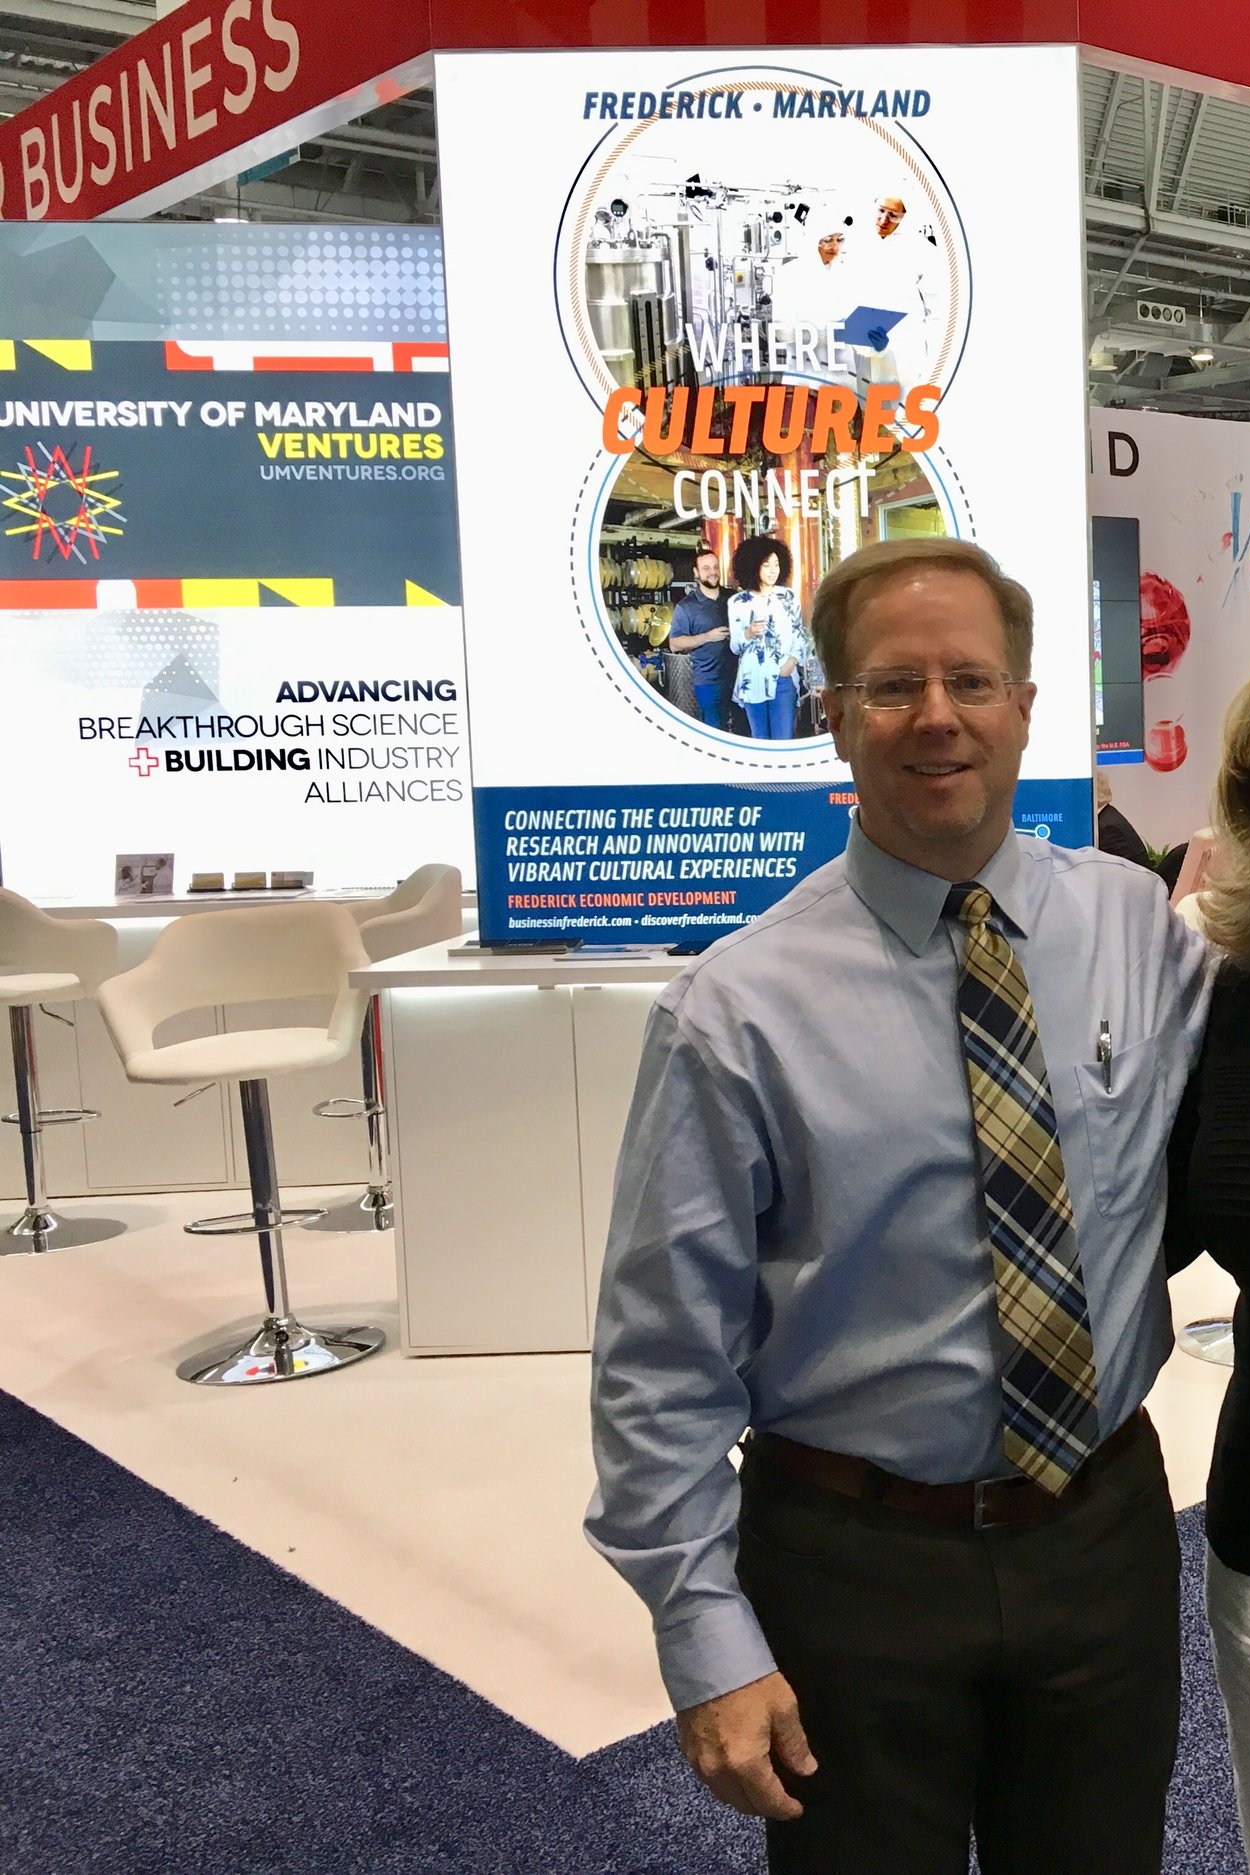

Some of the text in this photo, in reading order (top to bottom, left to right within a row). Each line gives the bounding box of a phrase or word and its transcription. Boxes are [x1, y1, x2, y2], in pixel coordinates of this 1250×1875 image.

[20, 0, 300, 220] BUSINESS
[583, 89, 931, 119] FREDERICK MARYLAND
[685, 322, 849, 373] WHERE
[0, 400, 442, 428] UNIVERSITY OF MARYLAND
[602, 385, 942, 456] CULTURES
[258, 432, 444, 459] VENTURES
[260, 464, 445, 481] UMVENTURES.ORG
[672, 467, 876, 519] CONNECT
[276, 680, 457, 702] ADVANCING
[79, 712, 458, 739] BREAKTHROUGH SCIENCE
[165, 746, 460, 772] BUILDING INDUSTRY
[305, 779, 463, 803] ALLIANCES
[504, 806, 762, 830] CONNECTING THE CULTURE OF
[1021, 813, 1063, 823] BALTIMORE
[506, 831, 805, 856] RESEARCH AND INNOVATION WITH
[508, 857, 797, 882] VIBRANT CULTURAL EXPERIENCES
[507, 891, 737, 909] FREDERICK ECONOMIC DEVELOPMENT
[508, 915, 632, 930] businessinfrederick.com
